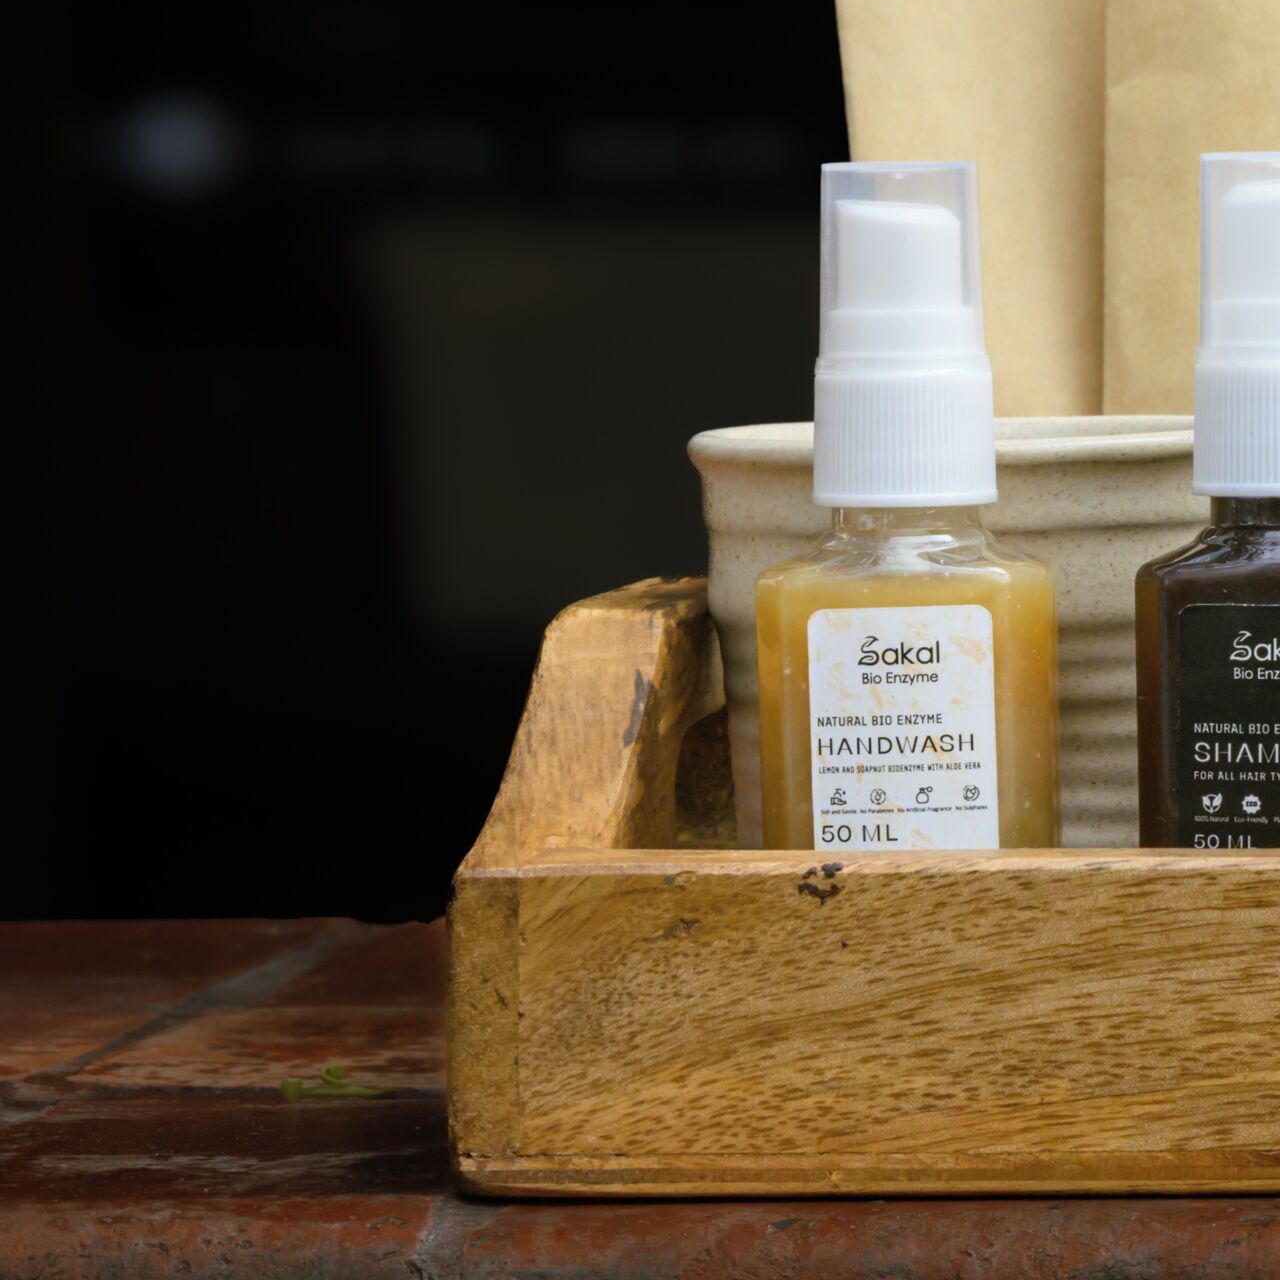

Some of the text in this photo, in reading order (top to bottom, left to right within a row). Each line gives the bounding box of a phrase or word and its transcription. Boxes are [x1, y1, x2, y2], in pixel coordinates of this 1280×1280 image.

[858, 636, 940, 666] Sakal
[862, 672, 938, 685] Bio Enzyme
[1234, 668, 1253, 679] Bio
[818, 714, 942, 727] NATURAL BIO ENZYME
[1194, 723, 1244, 734] NATURAL
[1249, 724, 1270, 734] BIO
[818, 734, 974, 755] HANDWASH
[857, 765, 886, 773] SOAPNUT
[888, 764, 924, 773] BIOENZYME
[928, 763, 943, 771] WITH
[1194, 771, 1213, 780] FOR
[1218, 772, 1235, 780] ALL
[1240, 772, 1266, 781] HAIR
[821, 824, 898, 842] 50 ML
[1194, 834, 1256, 848] 50 ML
